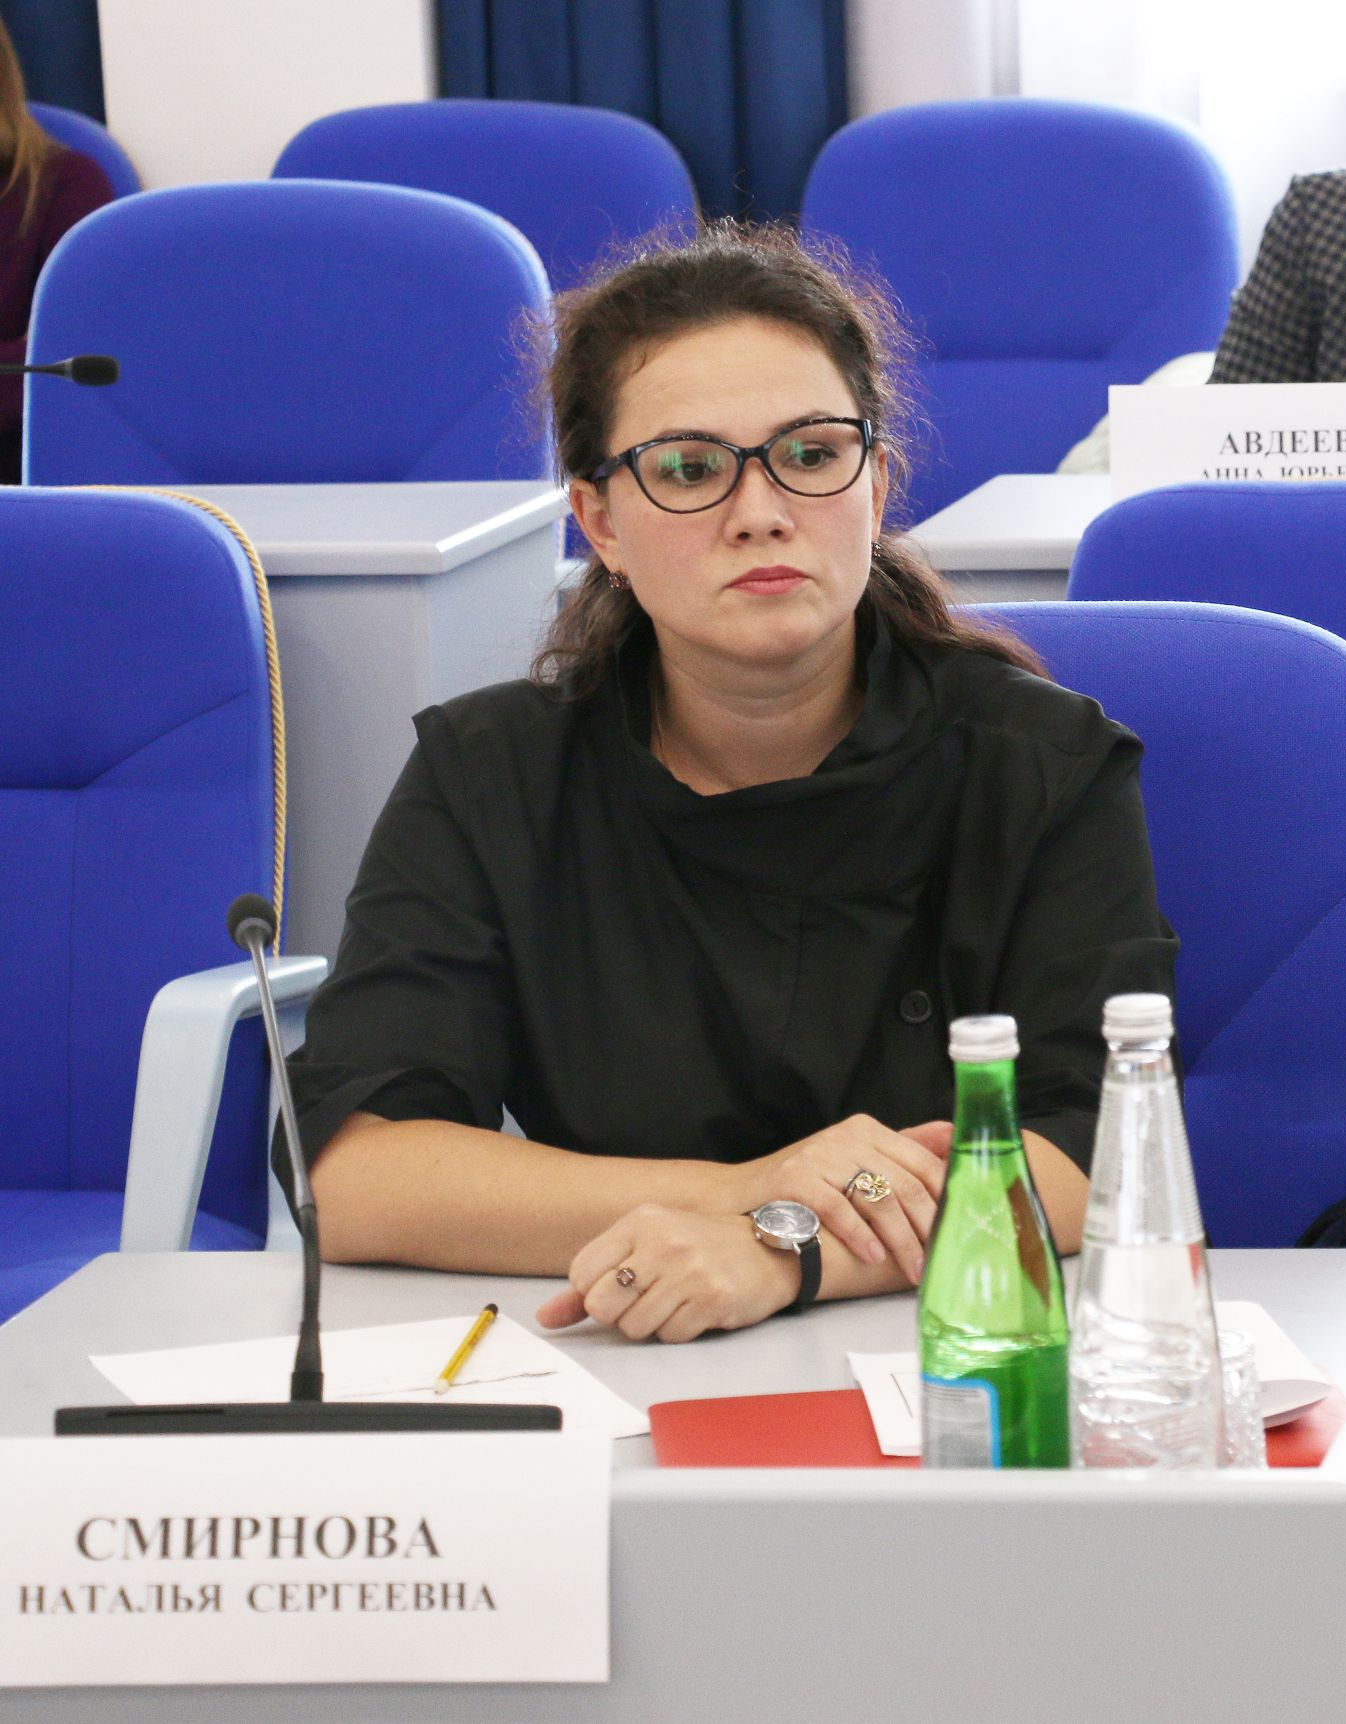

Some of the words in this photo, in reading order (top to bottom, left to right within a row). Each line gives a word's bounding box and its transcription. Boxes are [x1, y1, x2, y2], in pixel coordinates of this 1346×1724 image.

[75, 1514, 444, 1561] СМИРНОВА
[17, 1582, 225, 1616] НАТАЛЬЯ
[247, 1581, 499, 1613] СЕРГЕЕВНА
